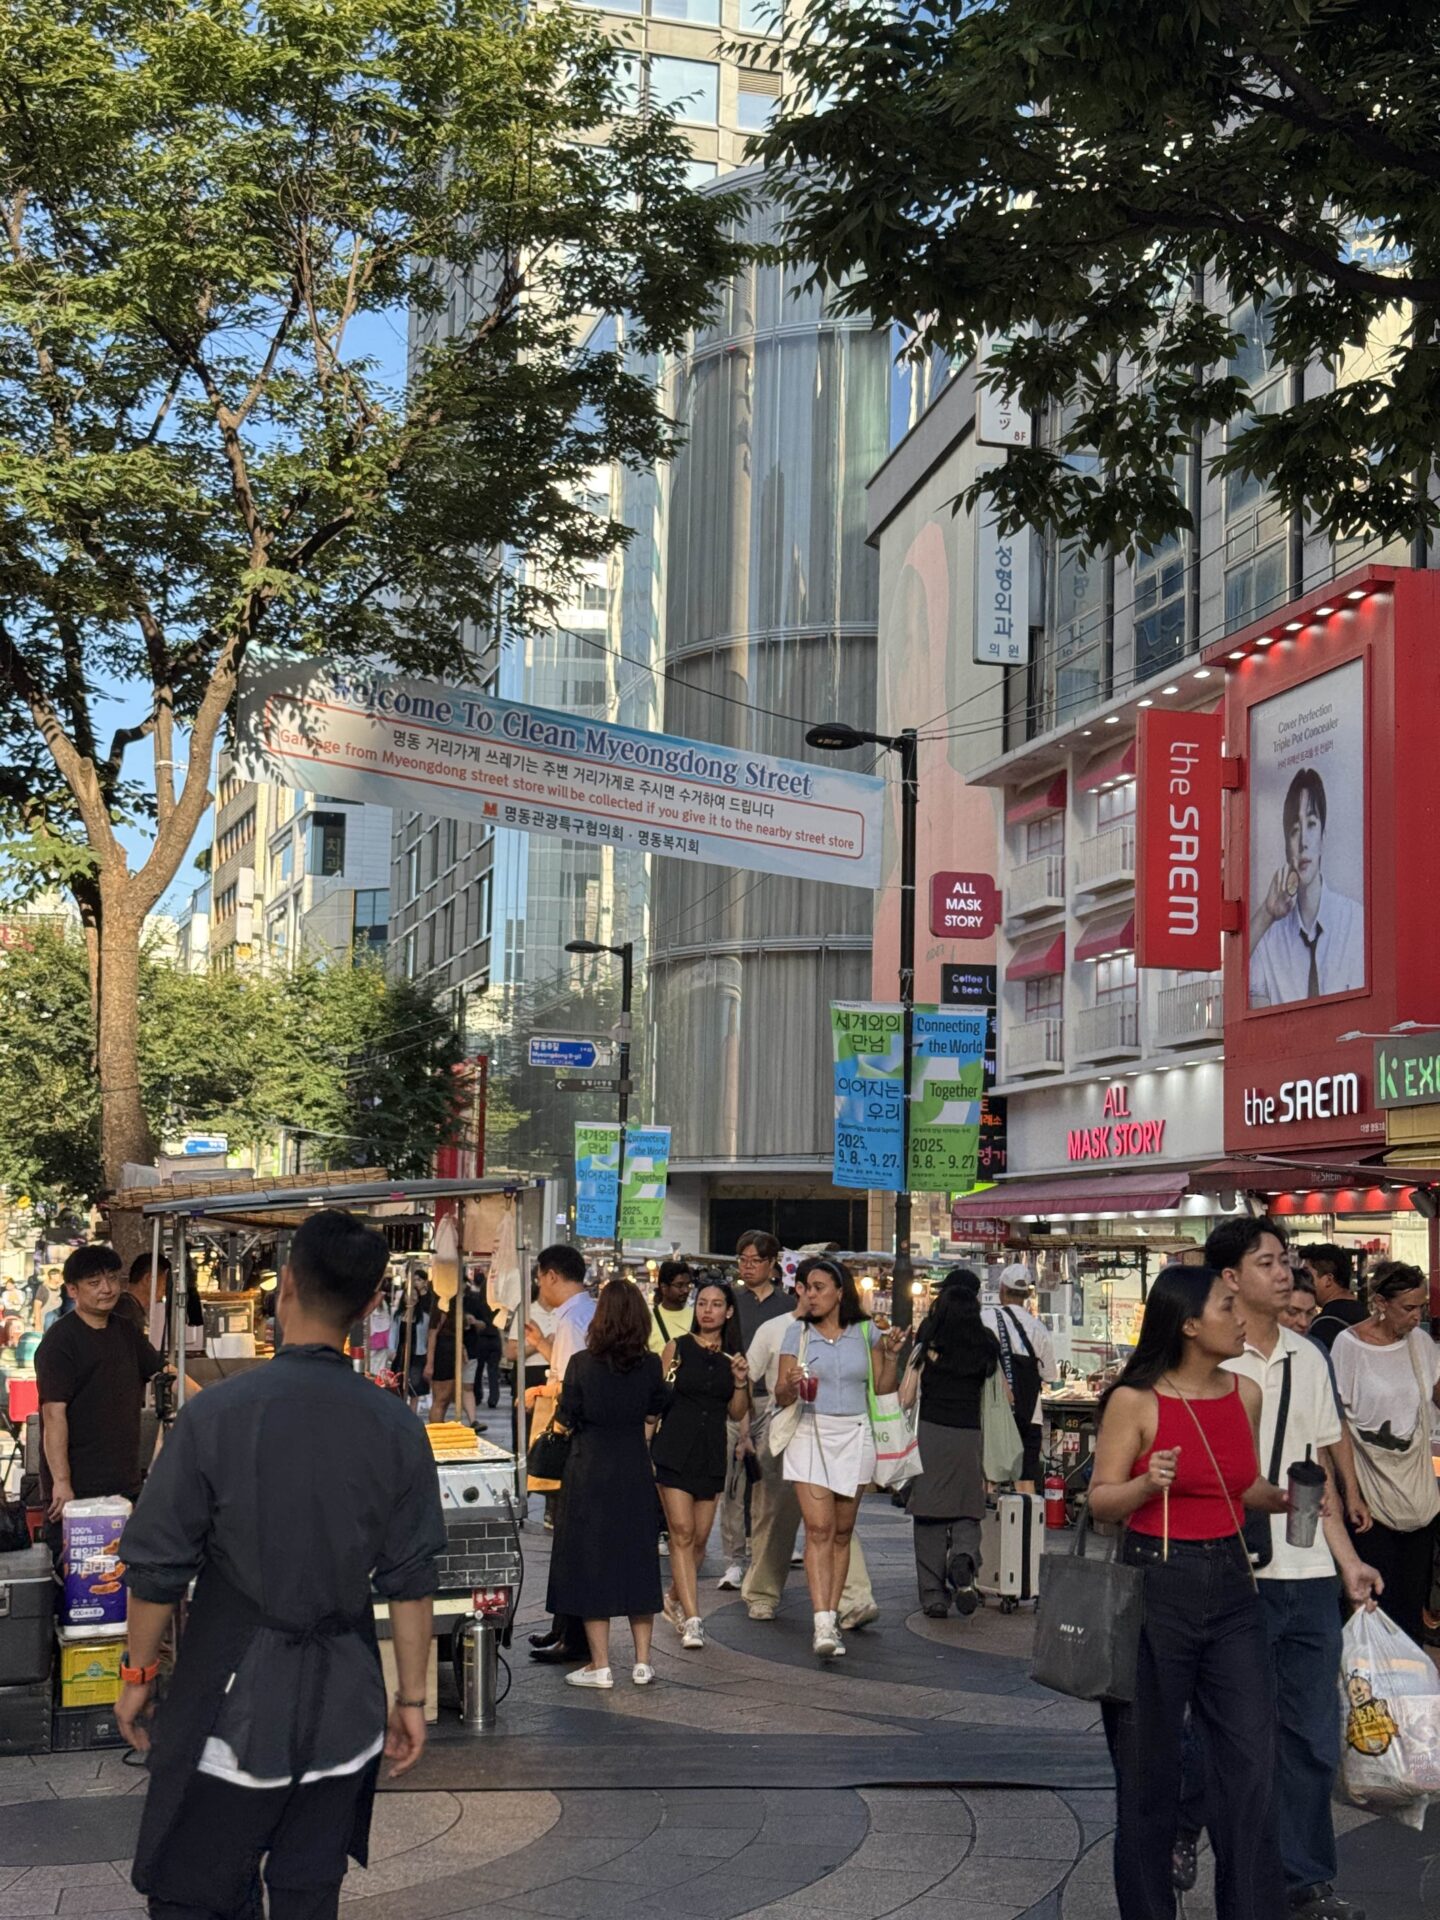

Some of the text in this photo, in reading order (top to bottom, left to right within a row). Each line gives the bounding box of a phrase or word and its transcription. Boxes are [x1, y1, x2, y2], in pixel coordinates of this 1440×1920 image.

[1014, 431, 1026, 441] 8F
[1278, 703, 1333, 734] Cover Perfection
[1273, 717, 1339, 754] Triple Pot Concealer
[462, 701, 493, 732] To
[503, 711, 577, 751] Clean
[585, 728, 739, 785] Myeongdong
[744, 761, 813, 798] Street
[393, 729, 775, 819] 명동 거리가게 쓰레기는 주변 거리가게로 주시면 수거하여 드립니다
[1170, 742, 1199, 796] the
[345, 742, 377, 761] from
[382, 750, 467, 782] Myeongdong
[471, 769, 509, 787] street
[513, 778, 545, 794] store
[588, 791, 643, 813] collected
[647, 800, 656, 815] if
[658, 804, 679, 823] you
[682, 806, 706, 827] give
[709, 811, 718, 826] it
[720, 815, 732, 829] to
[735, 817, 753, 834] the
[756, 822, 793, 842] nearby
[795, 828, 827, 847] street
[829, 834, 855, 850] store
[504, 804, 700, 855] 명동관광특구협의회 명동복지회
[952, 882, 976, 895] ALL
[945, 898, 982, 911] MASK
[944, 915, 983, 928] STORY
[952, 974, 983, 984] Coffee
[952, 985, 983, 995] & Beer
[836, 1013, 900, 1033] 세계와의
[917, 1017, 981, 1036] Connecting
[851, 1034, 885, 1053] 만남
[929, 1039, 983, 1054] the World
[838, 1077, 900, 1099] 이어지는
[930, 1083, 977, 1101] Together
[1104, 1086, 1130, 1118] ALL
[1244, 1087, 1275, 1126] the
[866, 1102, 900, 1121] 우리
[628, 1133, 667, 1144] Connecting
[838, 1133, 867, 1150] 2025.
[913, 1138, 946, 1153] 2025.
[1067, 1120, 1166, 1161] MASK STORY
[588, 1142, 608, 1154] 만남
[635, 1172, 664, 1184] Together
[70, 1527, 92, 1535] 100%
[70, 1546, 104, 1560] 데일리
